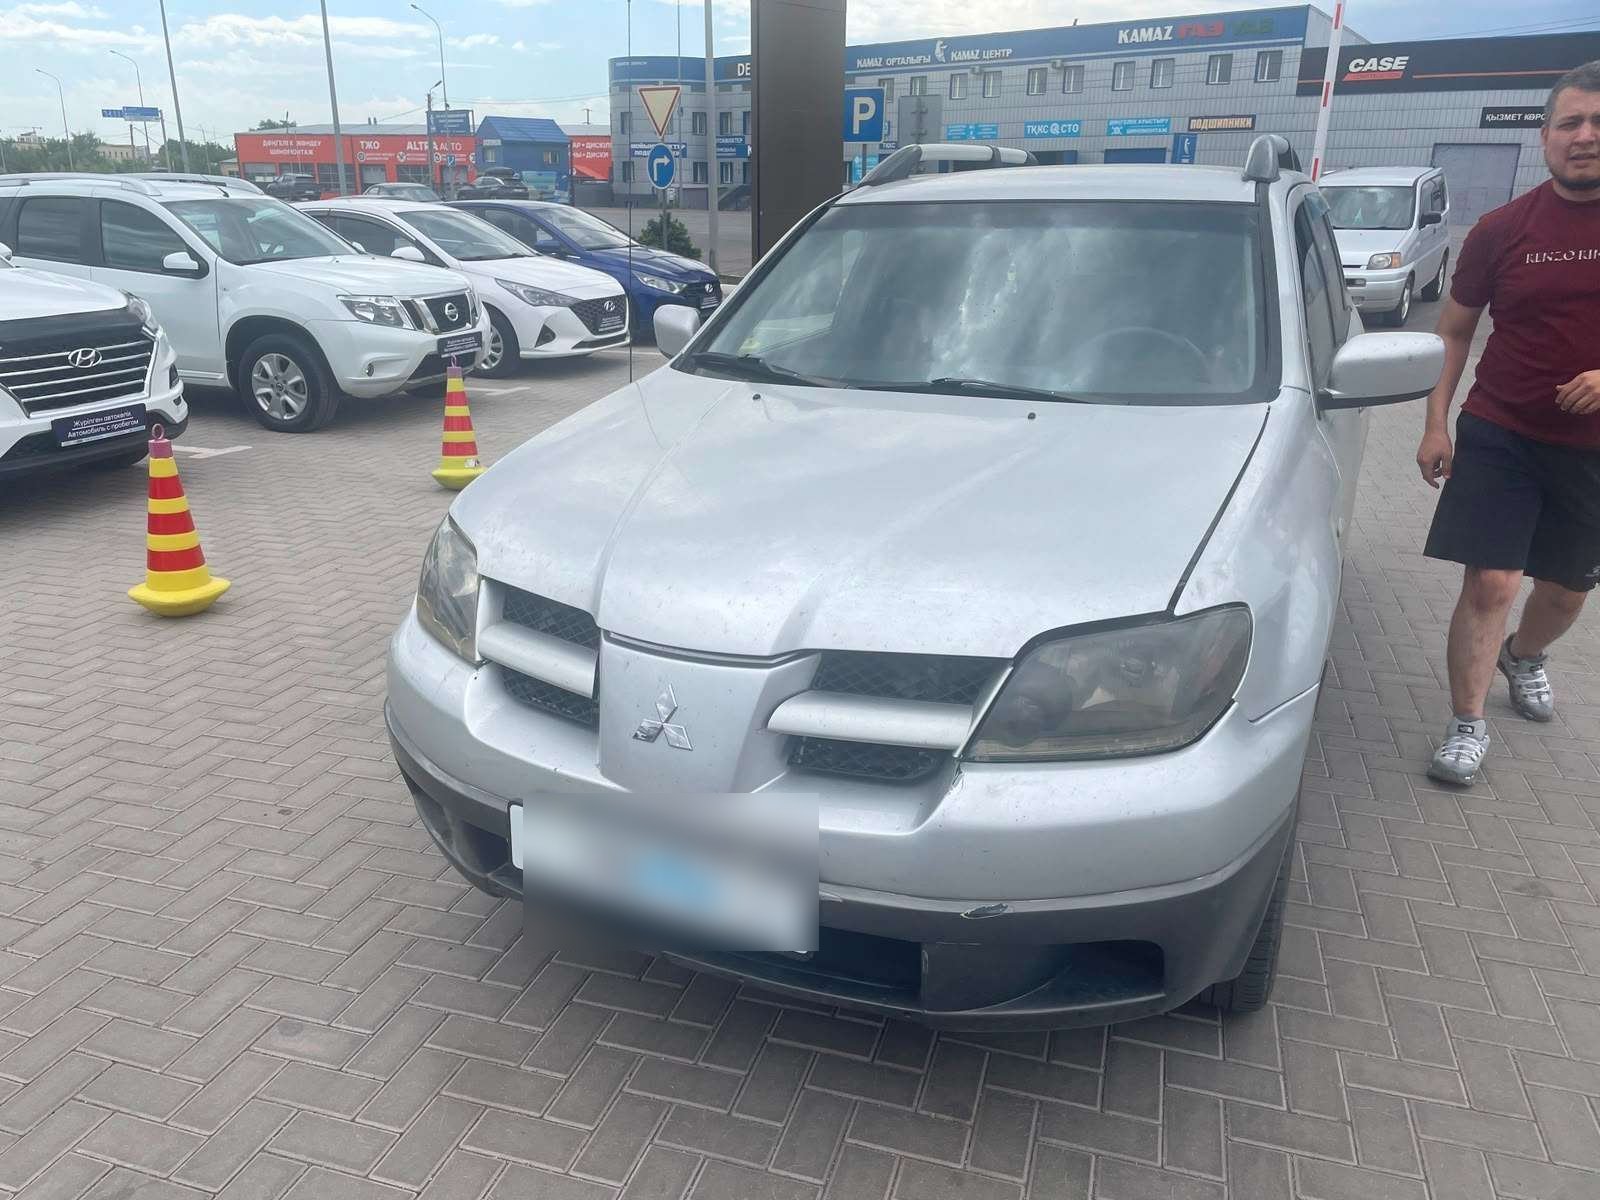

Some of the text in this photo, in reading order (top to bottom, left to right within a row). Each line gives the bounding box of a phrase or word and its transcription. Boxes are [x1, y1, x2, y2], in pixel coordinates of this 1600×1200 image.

[1118, 25, 1173, 44] KAMAZ
[951, 49, 980, 61] KAMAZ
[983, 48, 1013, 60] ЦЕНТР
[856, 58, 884, 68] KAMAZ
[1348, 56, 1410, 73] CASE
[852, 96, 876, 135] P
[1190, 116, 1252, 131] ПОДШИПНИКИ
[68, 425, 106, 439] Автомобиль
[112, 419, 139, 431] пробегом
